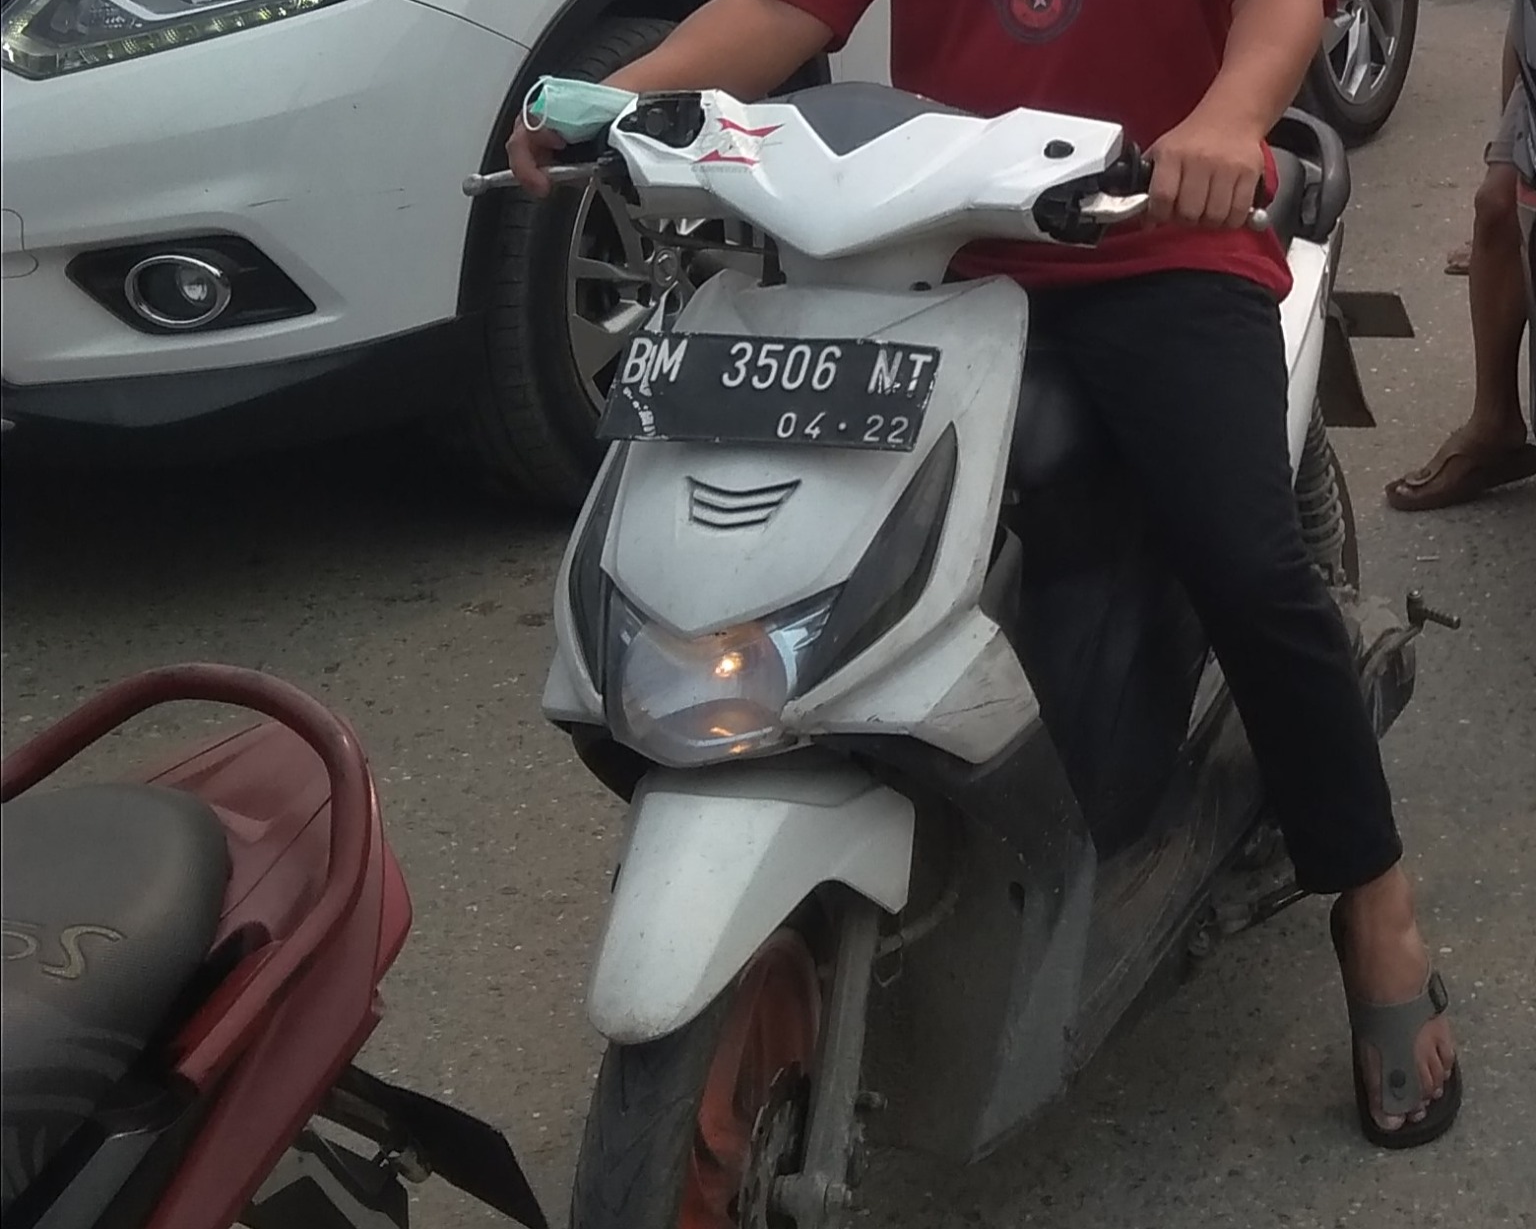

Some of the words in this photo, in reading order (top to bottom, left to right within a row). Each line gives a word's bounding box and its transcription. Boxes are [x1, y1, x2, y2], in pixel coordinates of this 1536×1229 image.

[621, 337, 688, 385] BM
[721, 341, 843, 391] 3506
[868, 348, 934, 397] NT
